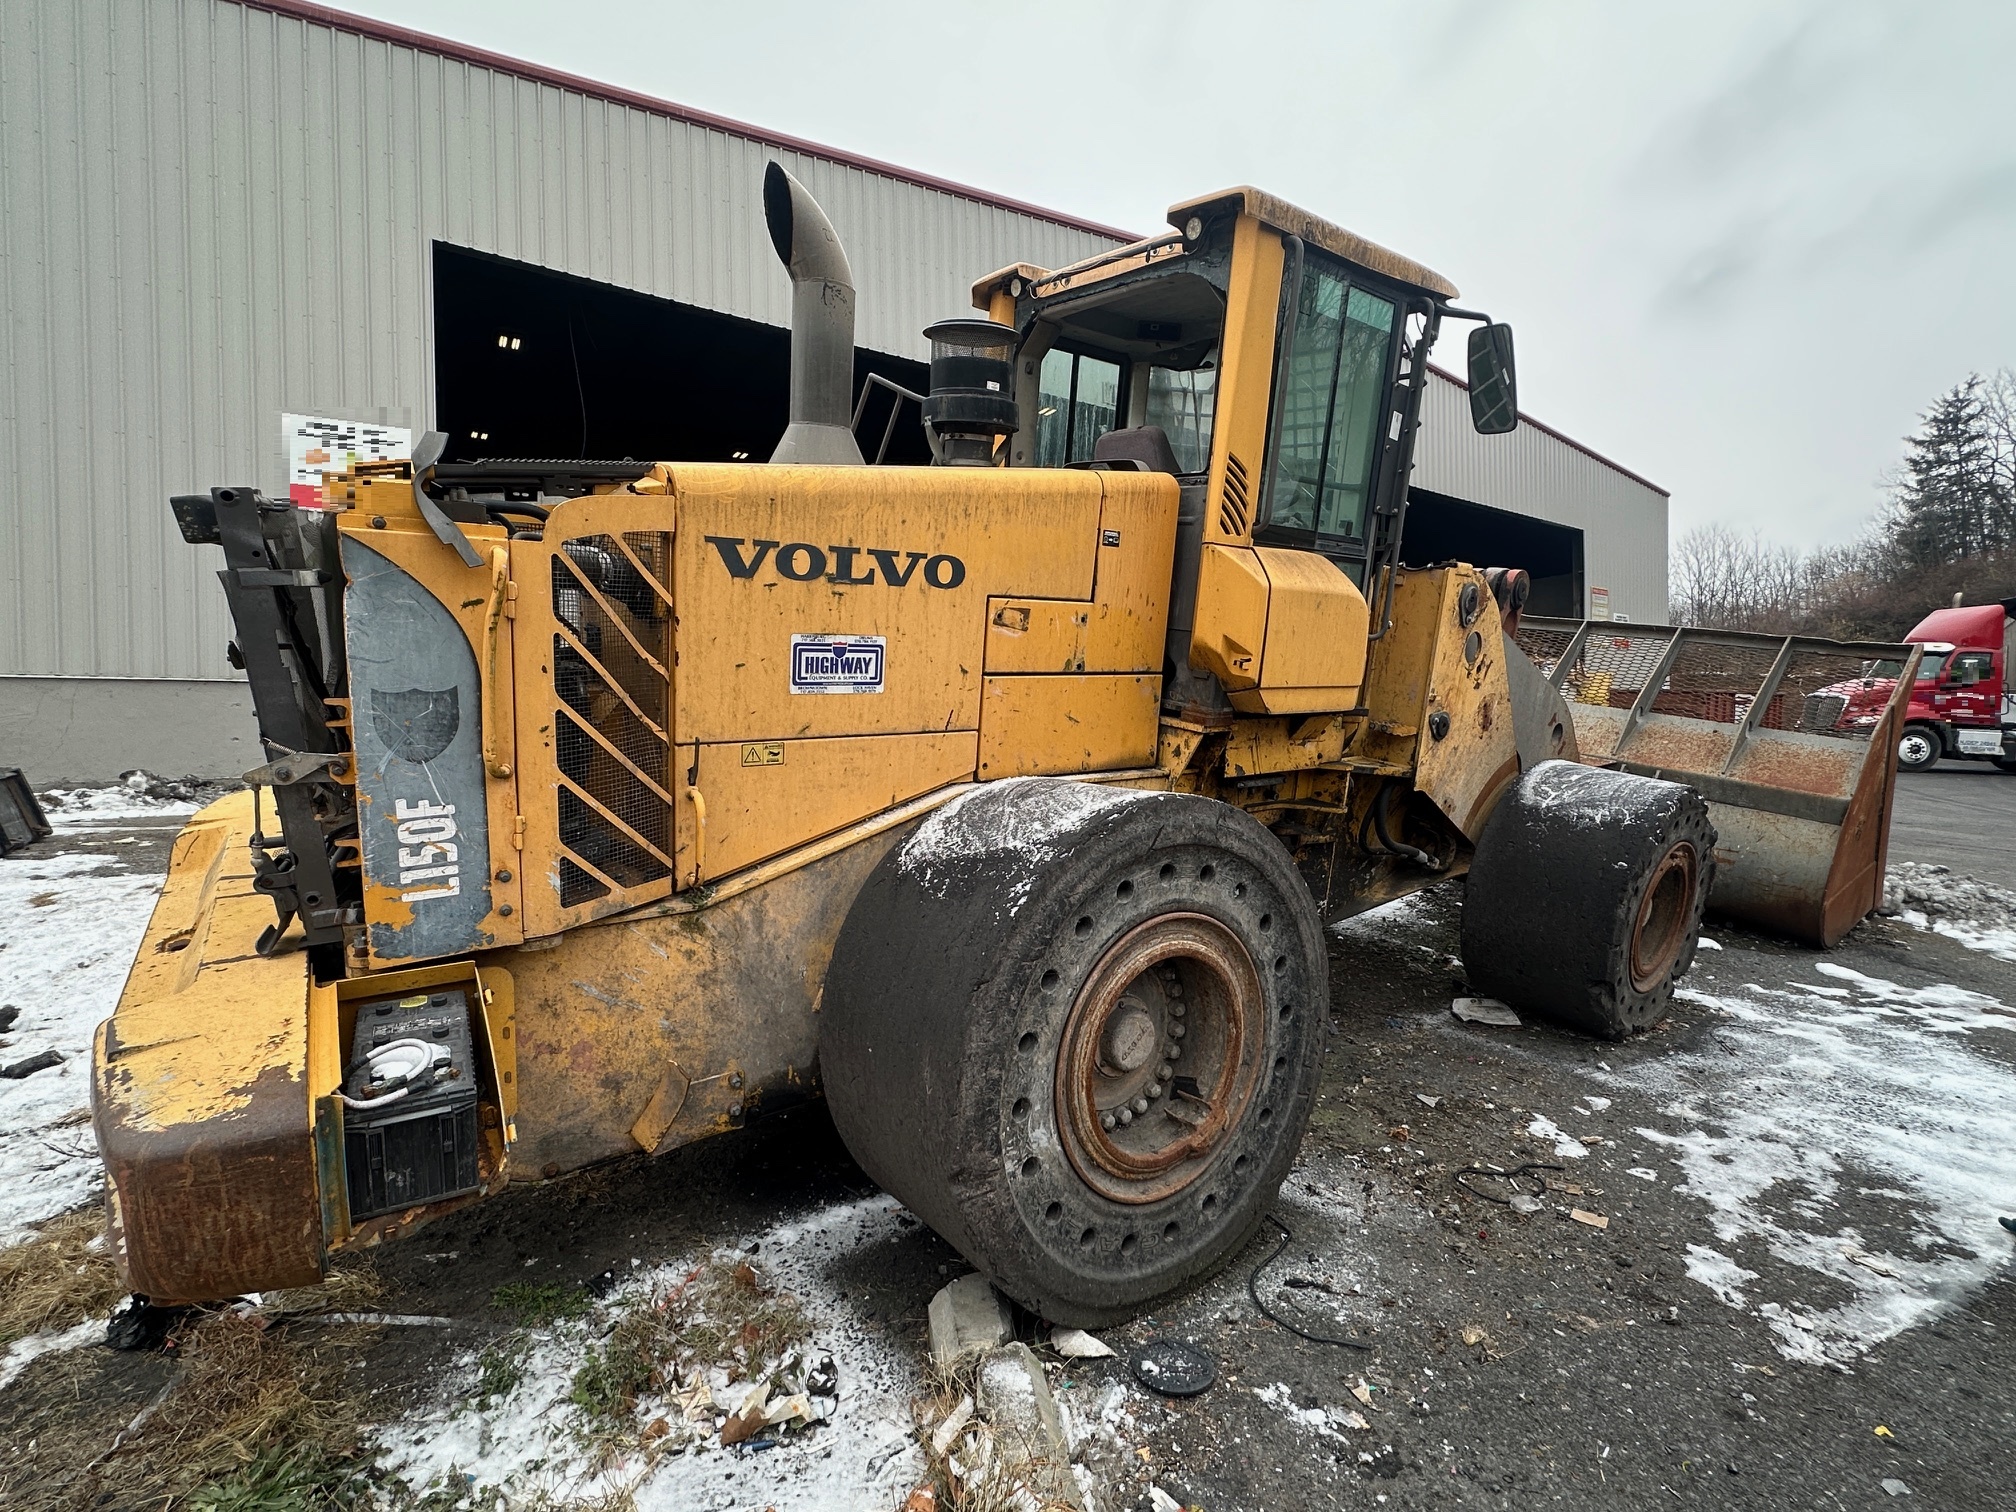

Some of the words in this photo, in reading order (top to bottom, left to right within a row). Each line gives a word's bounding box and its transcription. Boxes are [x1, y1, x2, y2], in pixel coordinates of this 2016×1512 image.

[704, 535, 966, 589] VOLVO
[805, 656, 873, 674] HIGHWAY
[395, 798, 460, 903] L150F
